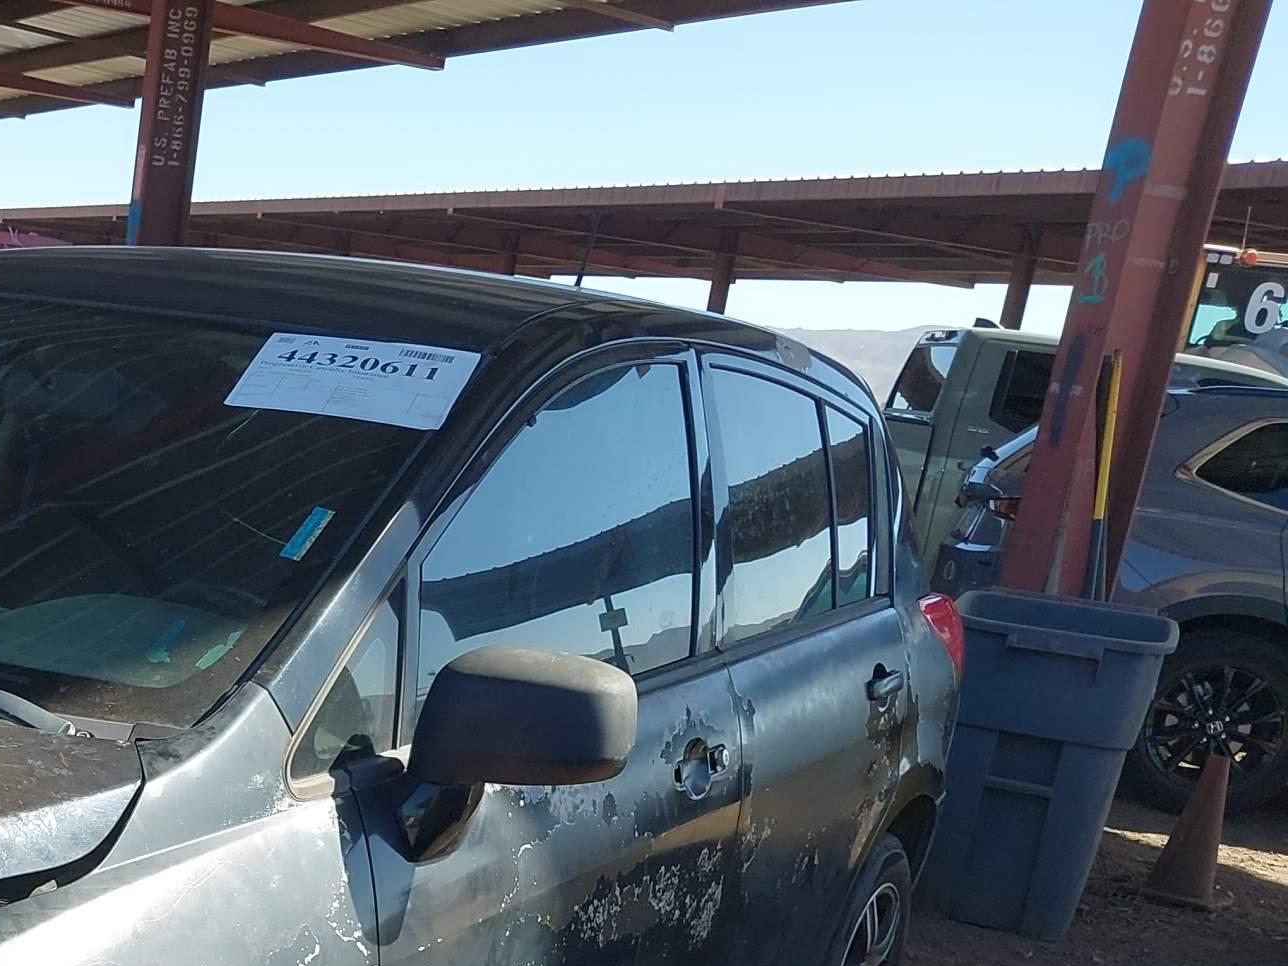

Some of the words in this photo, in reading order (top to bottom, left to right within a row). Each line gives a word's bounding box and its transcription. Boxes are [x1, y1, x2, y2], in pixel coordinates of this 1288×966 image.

[167, 8, 182, 38] INC
[157, 48, 178, 121] PREFAB
[168, 7, 199, 167] 1-866-799-0969
[152, 132, 168, 166] U.S.
[1244, 281, 1285, 334] 6
[277, 348, 440, 381] 44320611
